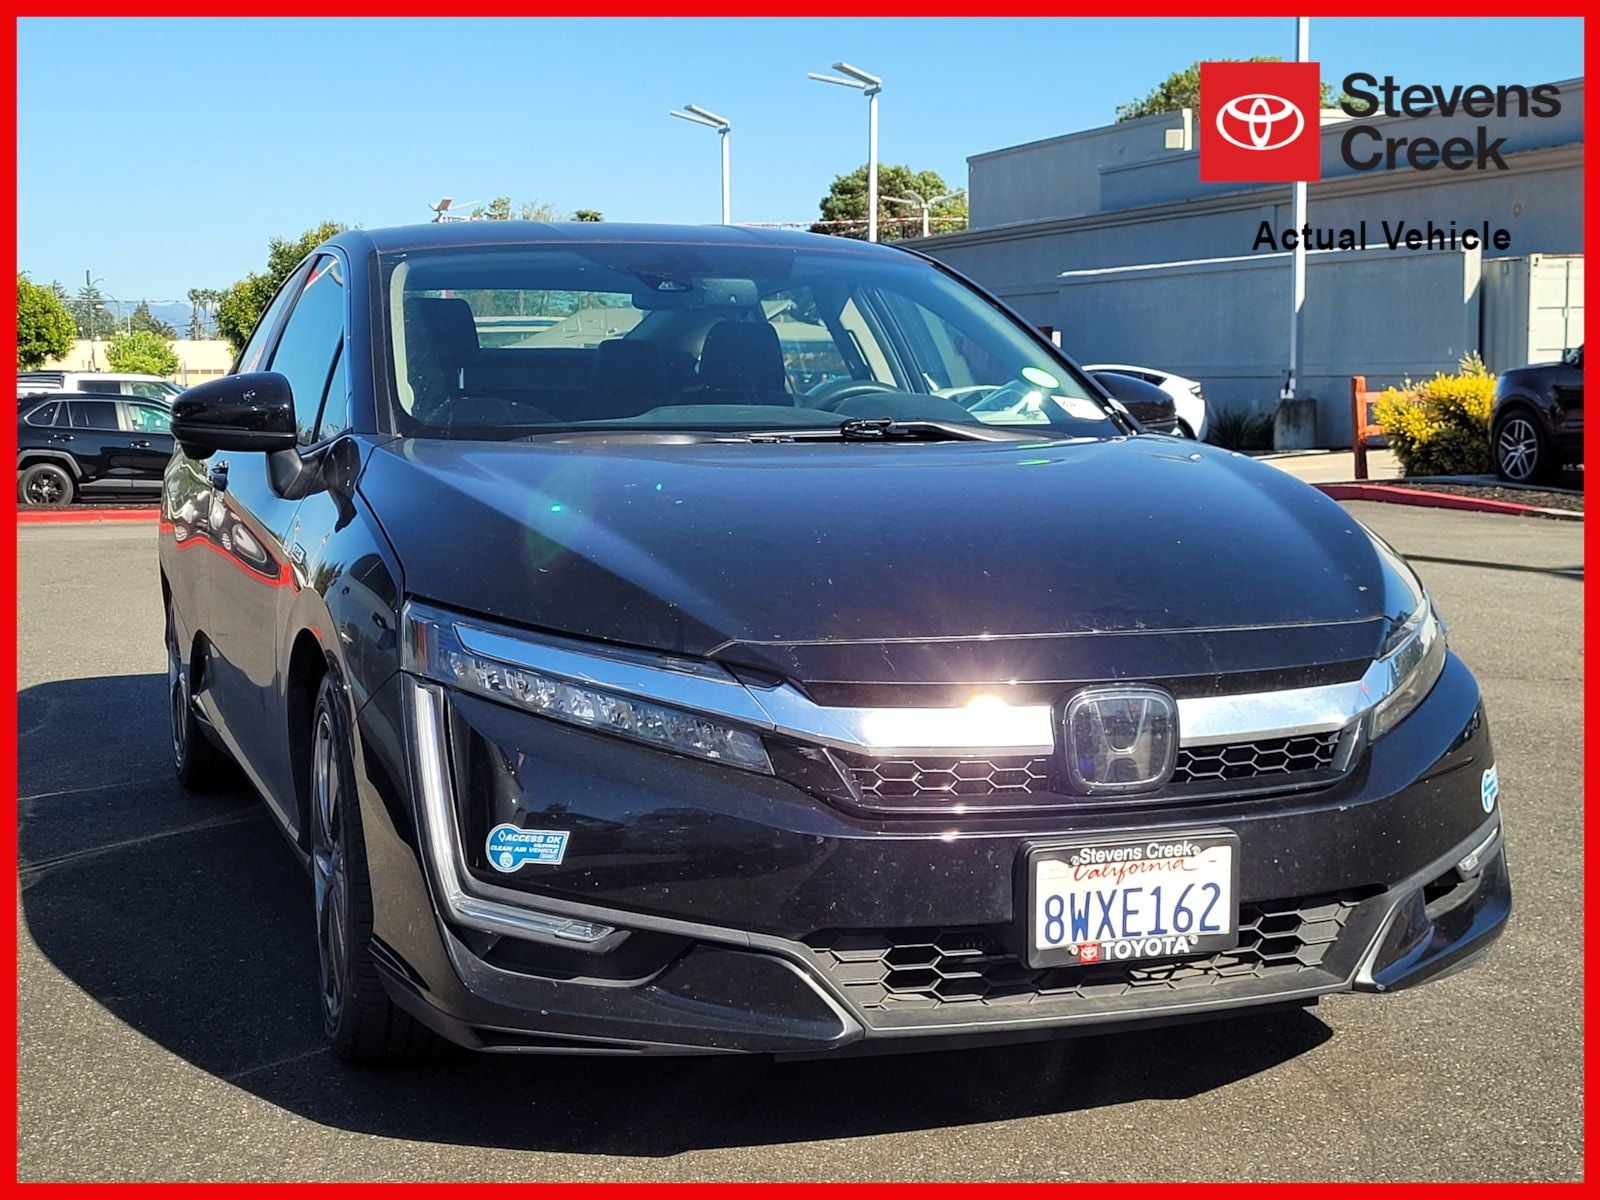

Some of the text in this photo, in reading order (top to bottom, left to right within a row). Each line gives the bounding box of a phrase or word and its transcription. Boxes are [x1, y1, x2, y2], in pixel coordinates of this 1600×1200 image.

[505, 834, 544, 843] ACCESS
[528, 846, 559, 854] VEHICLE
[1079, 840, 1193, 864] Stevens Creek
[1073, 858, 1198, 884] California
[1045, 882, 1221, 945] 8WXE162
[1102, 936, 1190, 960] TOYOTA
